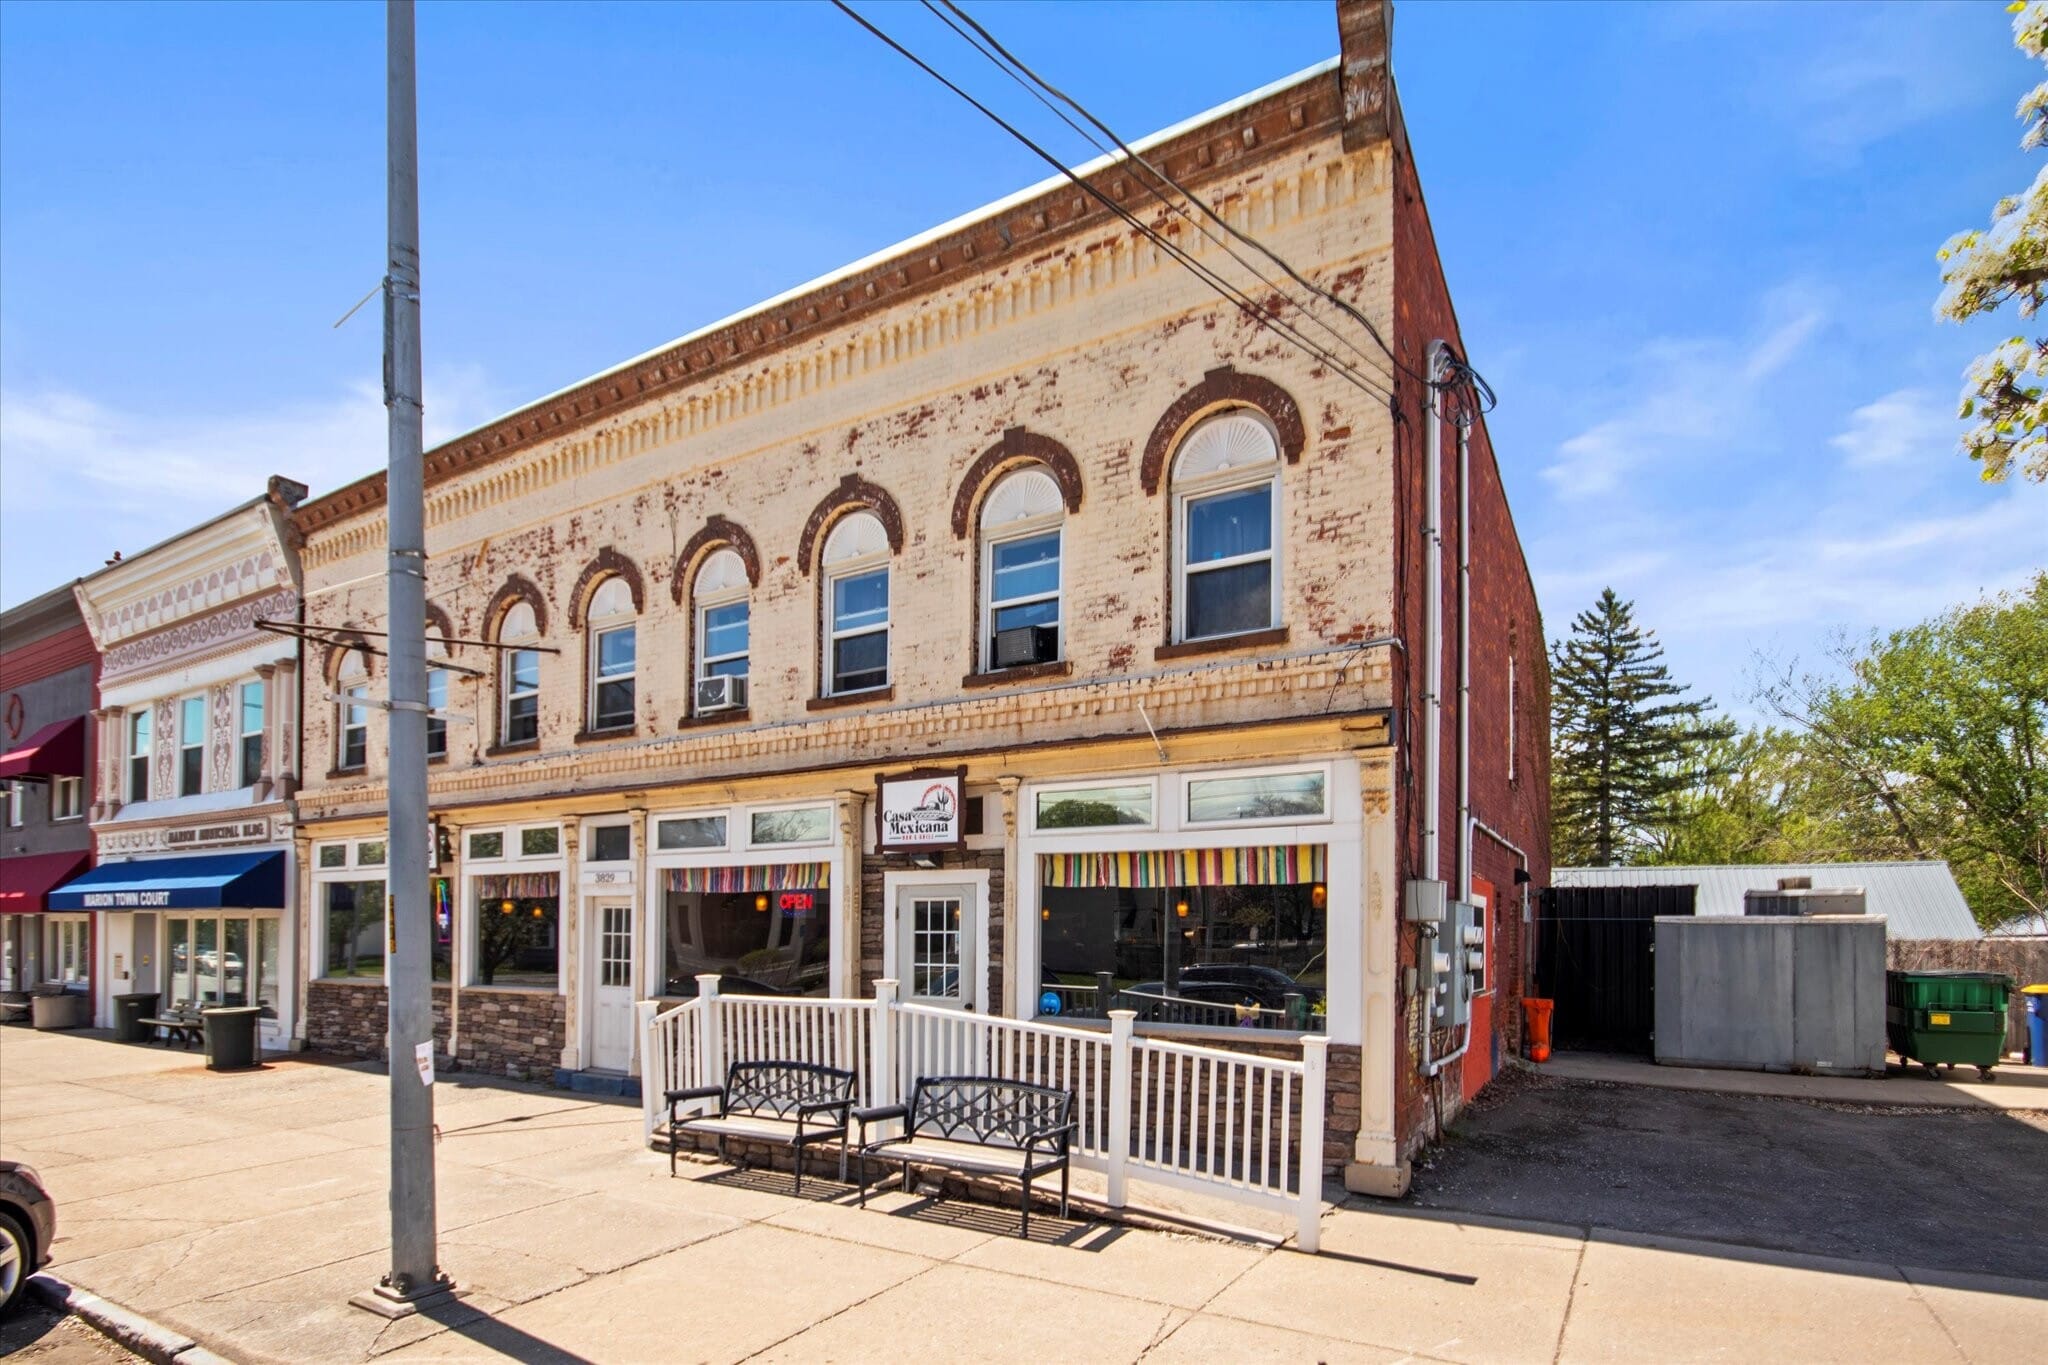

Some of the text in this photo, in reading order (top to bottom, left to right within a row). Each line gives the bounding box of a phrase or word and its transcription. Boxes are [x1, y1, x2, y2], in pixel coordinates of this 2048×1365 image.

[883, 810, 912, 823] Casa
[889, 820, 949, 835] Mexicana
[594, 872, 615, 883] 3829
[84, 891, 170, 907] MARION TOWN COURT
[779, 893, 814, 910] OPEN
